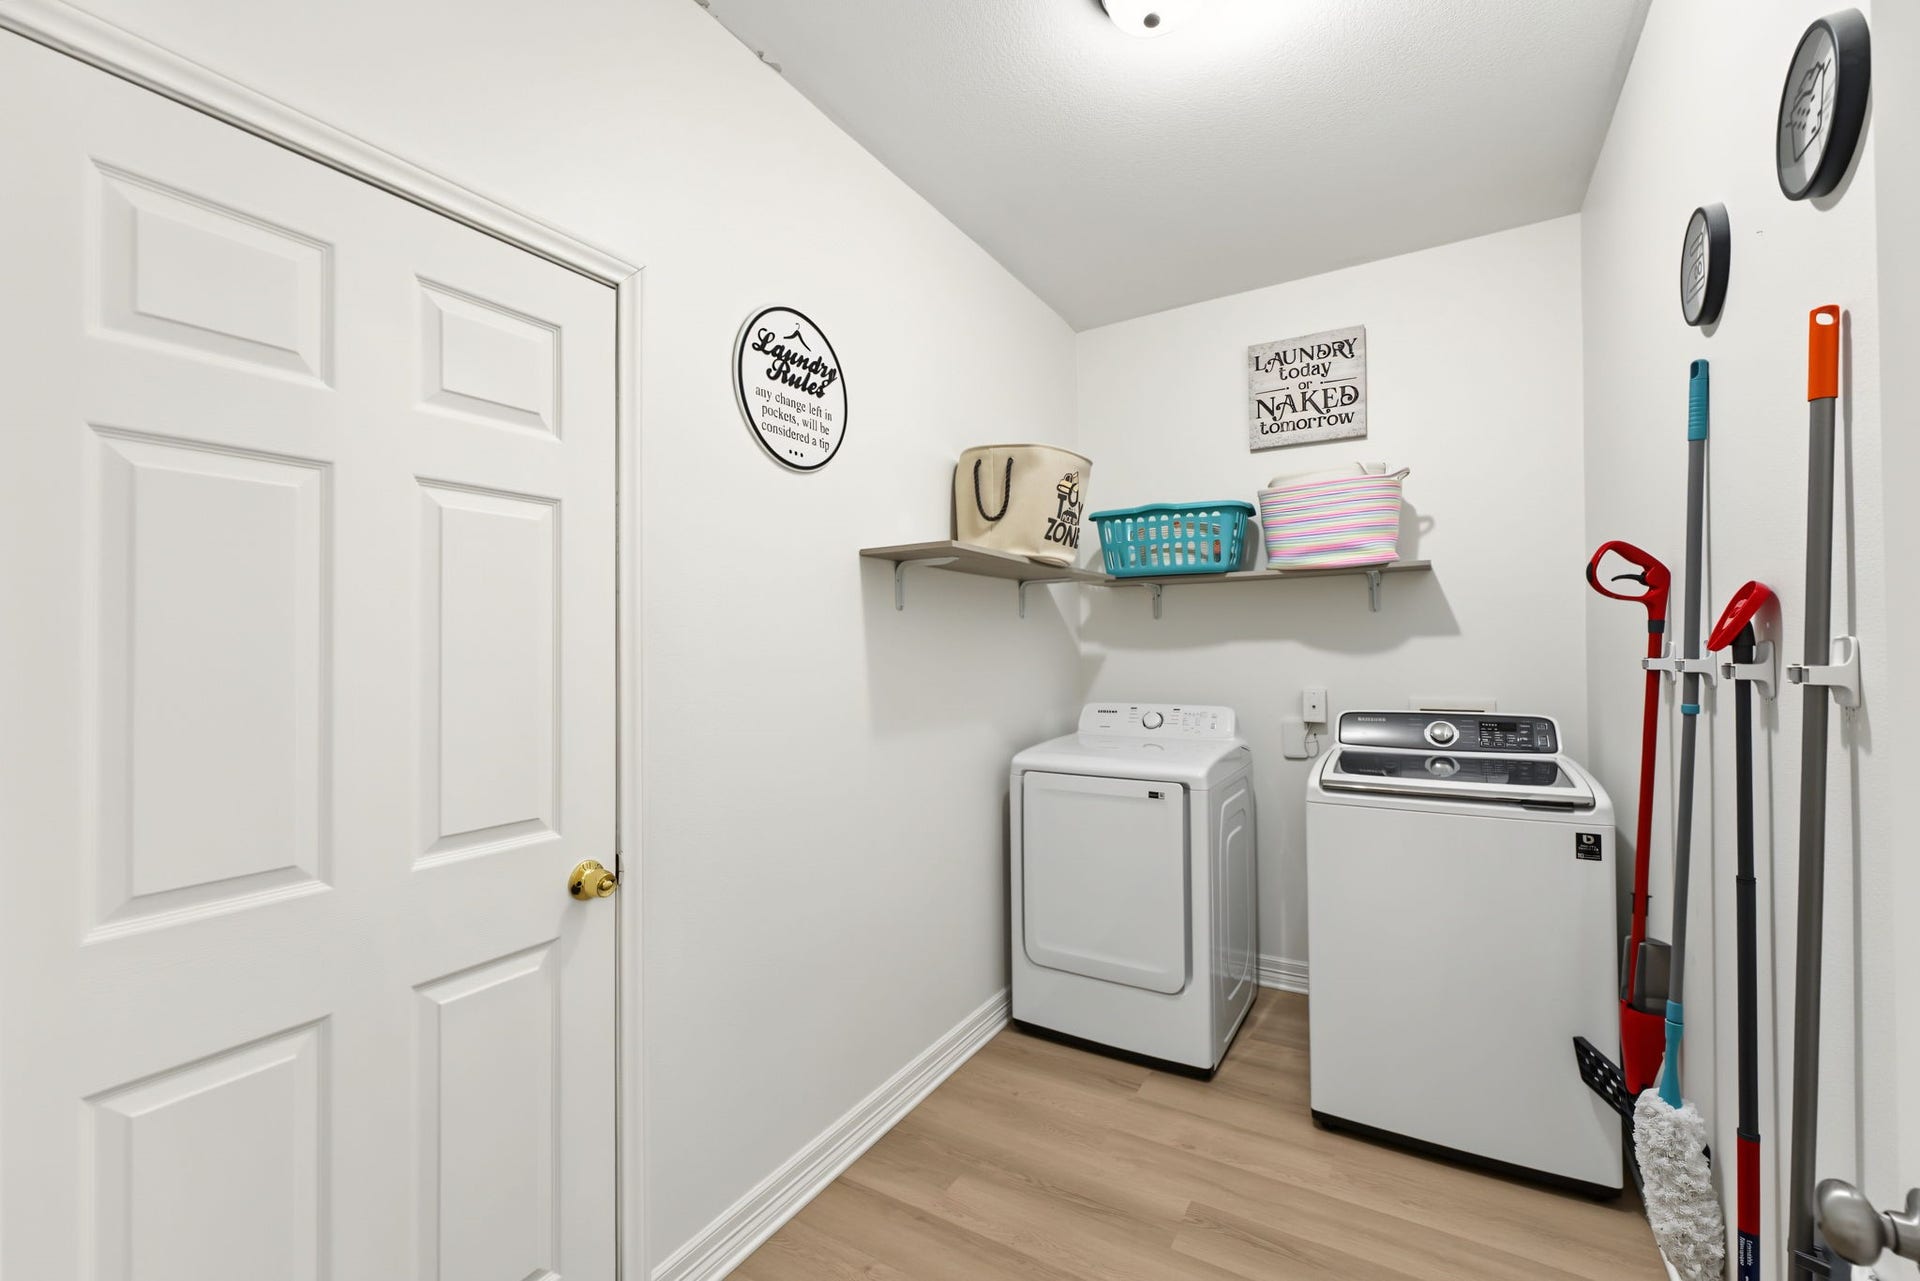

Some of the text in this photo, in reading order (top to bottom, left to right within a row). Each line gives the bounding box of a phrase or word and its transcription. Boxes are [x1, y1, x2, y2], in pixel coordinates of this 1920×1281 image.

[752, 328, 837, 383] Laundry
[1254, 337, 1358, 373] LAUNDRY
[1279, 362, 1332, 380] today
[766, 359, 825, 398] Rules
[1298, 381, 1312, 390] or
[755, 386, 832, 421] any change left in
[1255, 385, 1359, 421] NAKED
[761, 405, 830, 435] pockets, will be
[761, 420, 830, 453] considered a tip
[1260, 411, 1355, 435] tomorrow
[1044, 517, 1080, 549] ZONE
